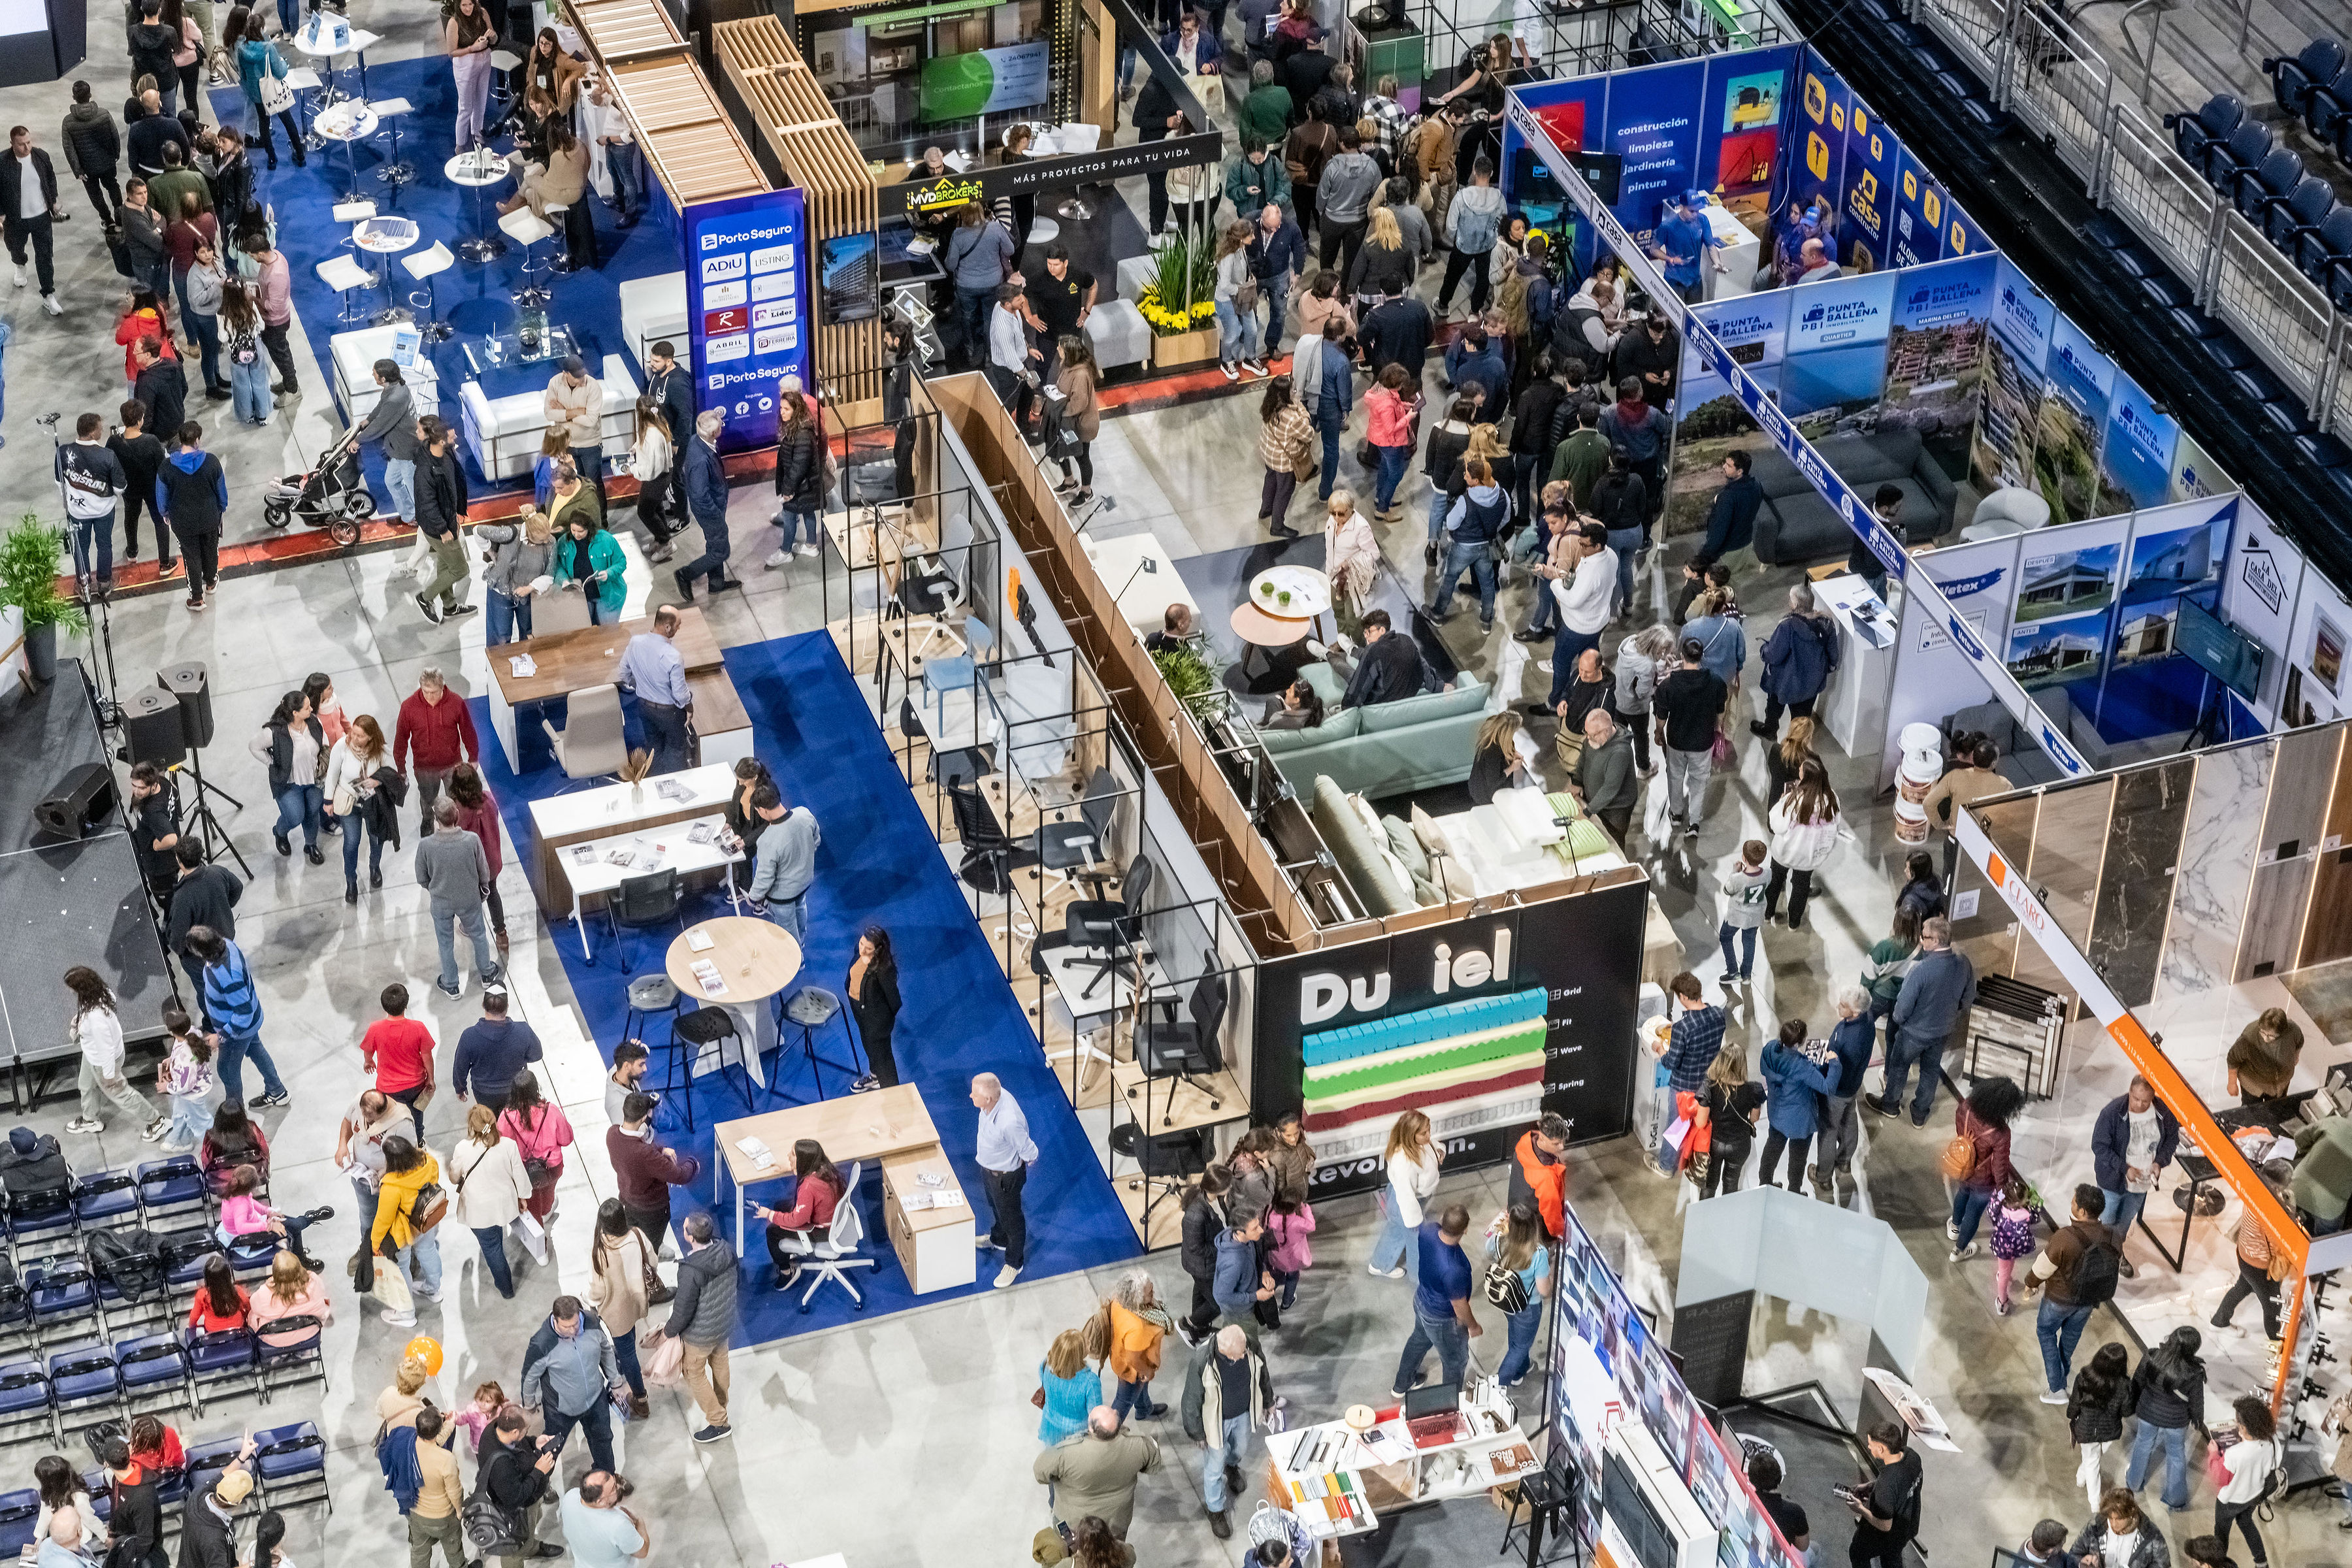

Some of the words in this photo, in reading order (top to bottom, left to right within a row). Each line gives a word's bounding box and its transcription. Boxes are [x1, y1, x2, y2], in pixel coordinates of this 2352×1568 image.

[881, 11, 917, 21] INMOBILIARIA
[919, 5, 959, 14] ESPECIALIZADA
[1520, 112, 1535, 137] casa
[1618, 117, 1688, 136] construcción
[1628, 139, 1674, 154] limpieza
[1014, 174, 1036, 184] MÁS
[1042, 162, 1105, 180] PROYECTOS
[1113, 156, 1140, 167] PARA
[1145, 153, 1158, 162] TU
[1164, 148, 1190, 159] VIDA
[1622, 157, 1676, 176] jardinería
[1627, 178, 1667, 194] pintura
[1851, 189, 1881, 231] casa
[1606, 221, 1622, 246] casa
[1849, 205, 1879, 242] constructor
[719, 232, 749, 245] Porto
[751, 225, 792, 239] Seguro
[755, 254, 790, 267] LISTING
[1932, 287, 1982, 303] BALLENA
[1934, 282, 1970, 295] PUNTA
[1827, 307, 1878, 322] BALLENA
[1828, 301, 1866, 314] PUNTA
[1918, 316, 1942, 325] MARINA
[1953, 310, 1967, 319] ESTE
[2017, 298, 2037, 325] PUNTA
[1722, 321, 1773, 337] BALLENA
[1723, 316, 1761, 329] PUNTA
[2016, 306, 2043, 340] BALLENA
[716, 340, 743, 350] ABRIL
[1700, 332, 1715, 351] PUNTA
[1823, 331, 1853, 342] QUARTIER
[1699, 338, 1718, 365] BALLENA
[726, 372, 757, 384] Porto
[757, 364, 798, 378] Seguro
[2074, 357, 2097, 384] PUNTA
[1766, 413, 1786, 442] BALLENA
[1767, 407, 1782, 429] PUNTA
[2135, 415, 2158, 442] PUNTA
[2133, 423, 2164, 461] BALLENA
[1807, 463, 1827, 490] BALLENA
[1808, 456, 1823, 478] PUNTA
[1879, 543, 1901, 570] BALLENA
[1880, 536, 1896, 559] PUNTA
[2262, 560, 2270, 576] LA
[1940, 580, 1979, 596] Vetex
[2250, 561, 2265, 583] CASA
[2267, 578, 2278, 596] DEL
[2247, 572, 2277, 606] REVESTIMIENTO
[1957, 628, 1974, 654] Vetex
[2051, 740, 2070, 766] Vetex
[1749, 885, 1763, 904] 7
[2009, 880, 2044, 930] CLARO
[1563, 987, 1582, 997] Grid
[1560, 1045, 1582, 1055] Wave
[2119, 1032, 2128, 1047] 099
[2128, 1043, 2137, 1058] 112
[2136, 1054, 2145, 1068] 404
[1558, 1079, 1584, 1090] Spring
